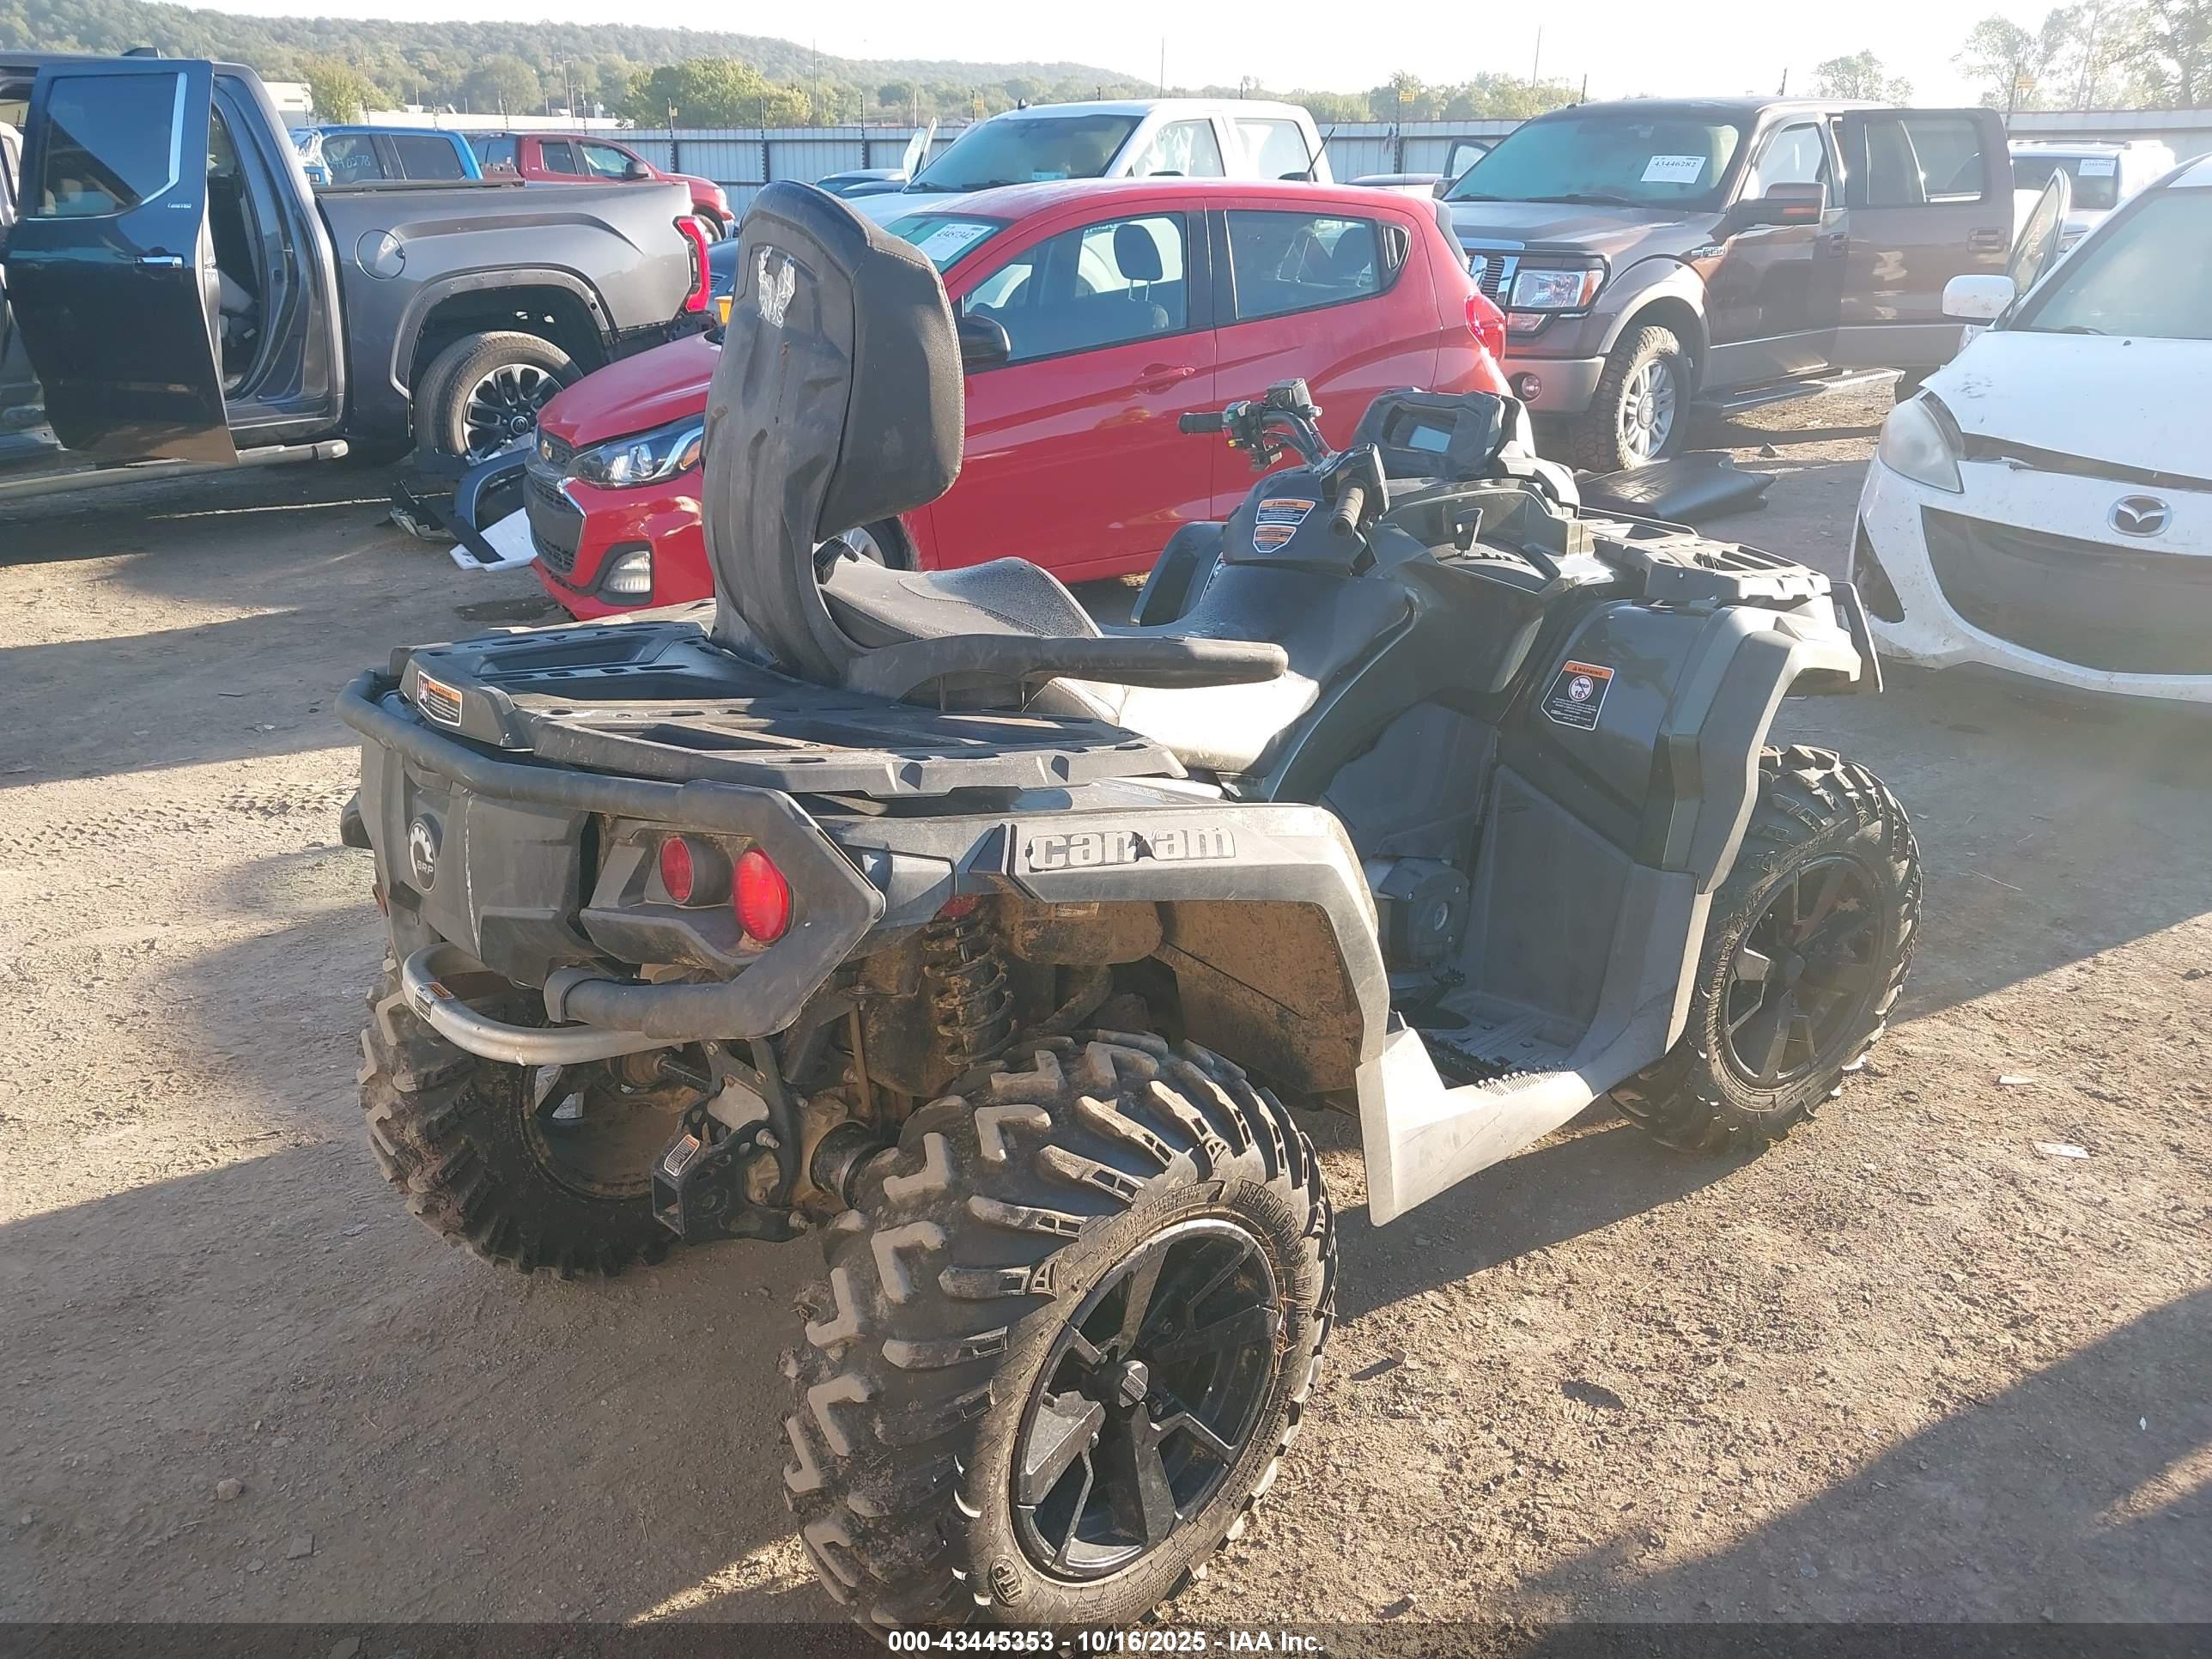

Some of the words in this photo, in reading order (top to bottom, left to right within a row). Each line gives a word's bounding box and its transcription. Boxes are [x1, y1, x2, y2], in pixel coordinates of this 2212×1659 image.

[1579, 666, 1603, 677] WARNING
[416, 860, 434, 875] BRP
[1237, 1179, 1282, 1219] TERRA
[1275, 1210, 1309, 1270] CROSS
[993, 1563, 1022, 1607] ITP
